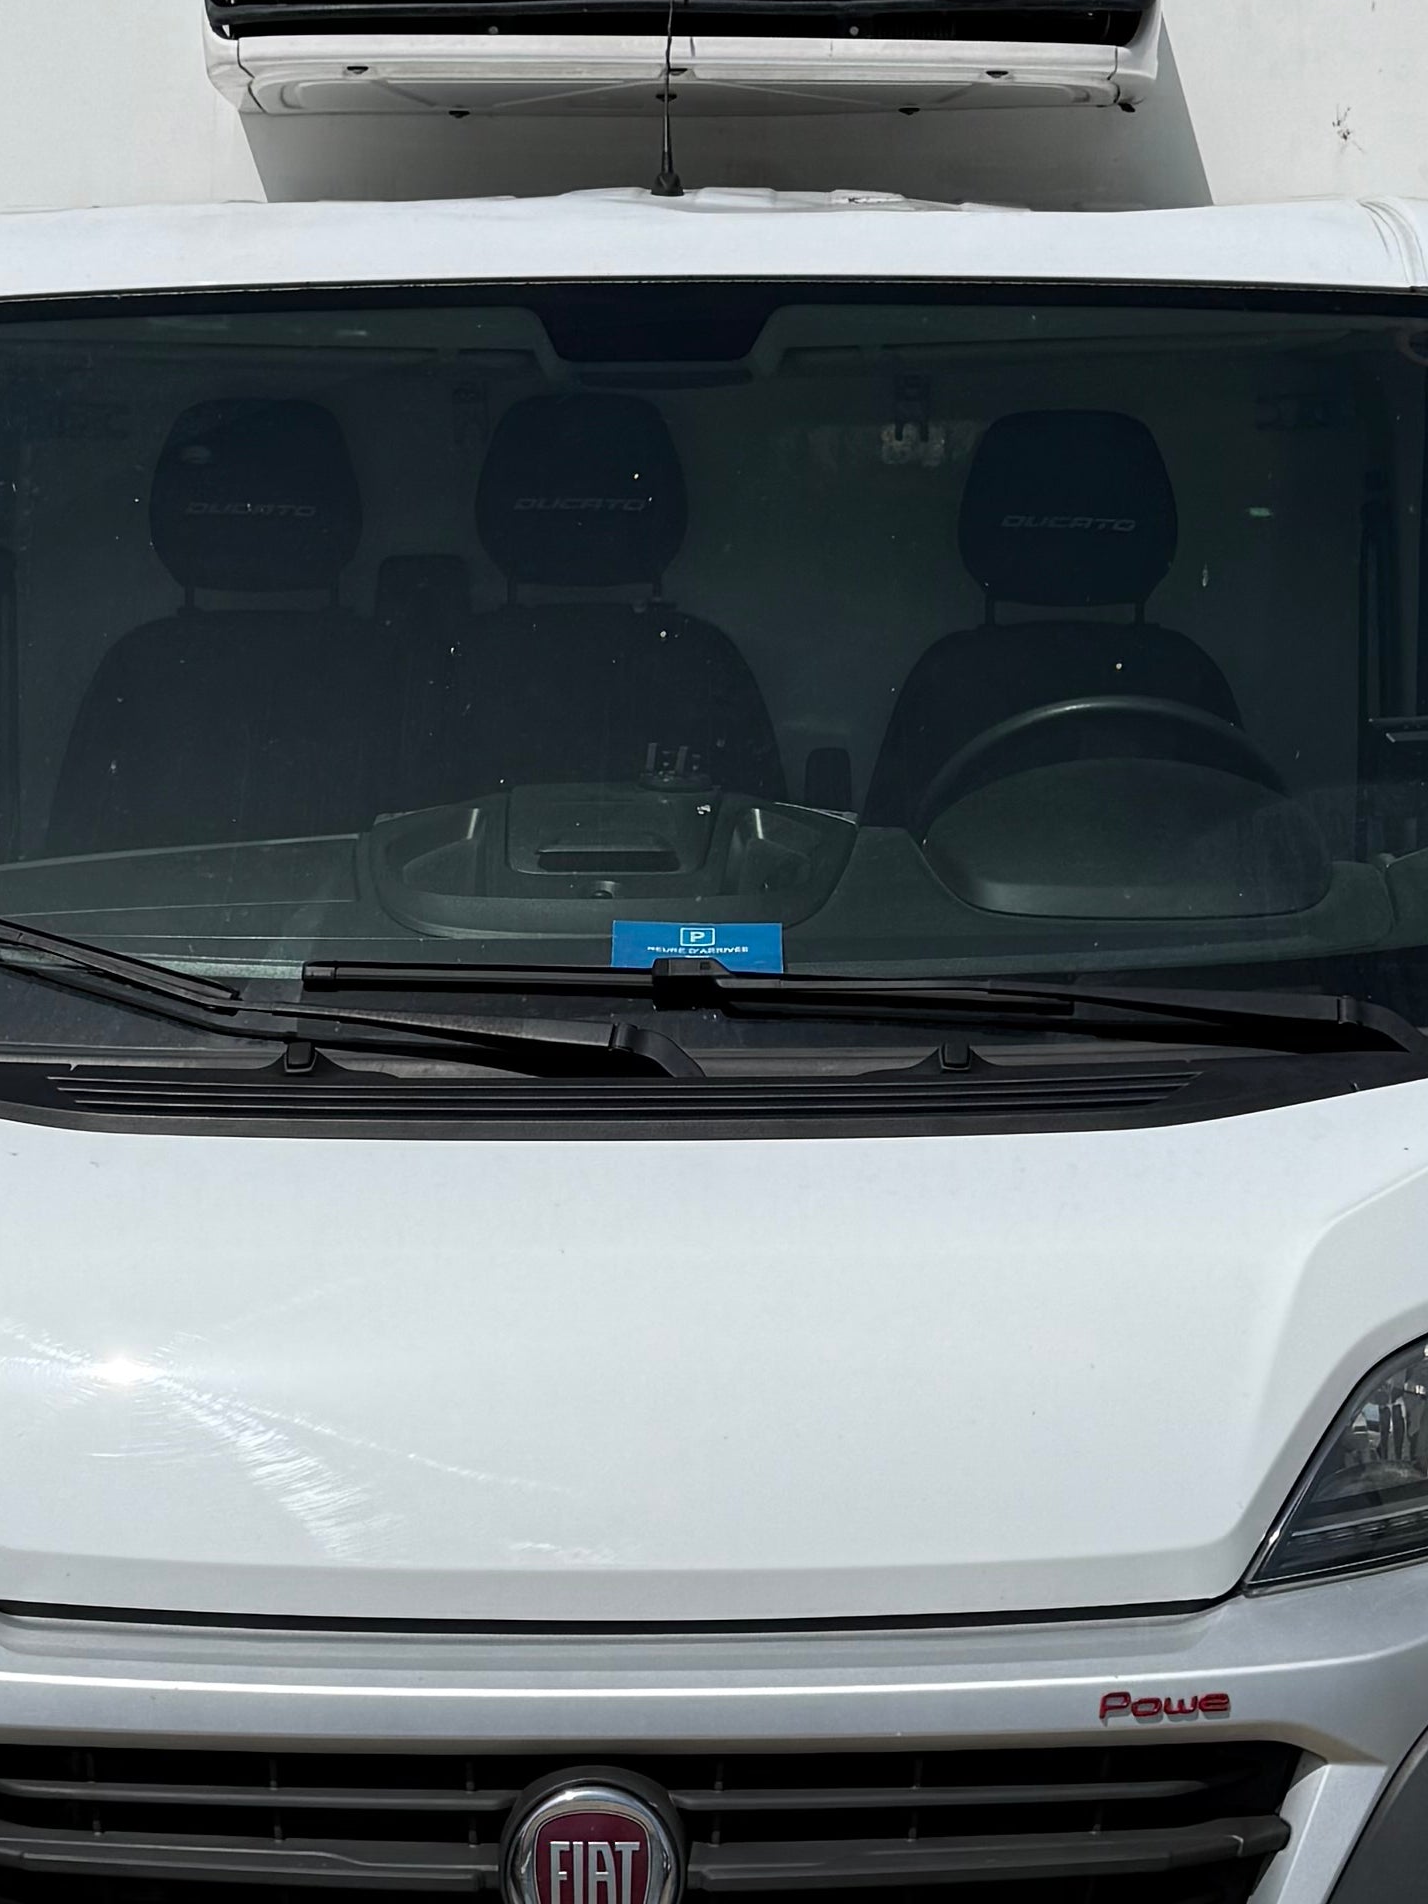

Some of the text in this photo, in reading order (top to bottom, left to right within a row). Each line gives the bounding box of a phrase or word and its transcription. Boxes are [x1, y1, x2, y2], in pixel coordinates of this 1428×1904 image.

[514, 497, 646, 512] DUCATO
[1001, 514, 1136, 532] DUCATO
[1098, 1691, 1230, 1720] Powe
